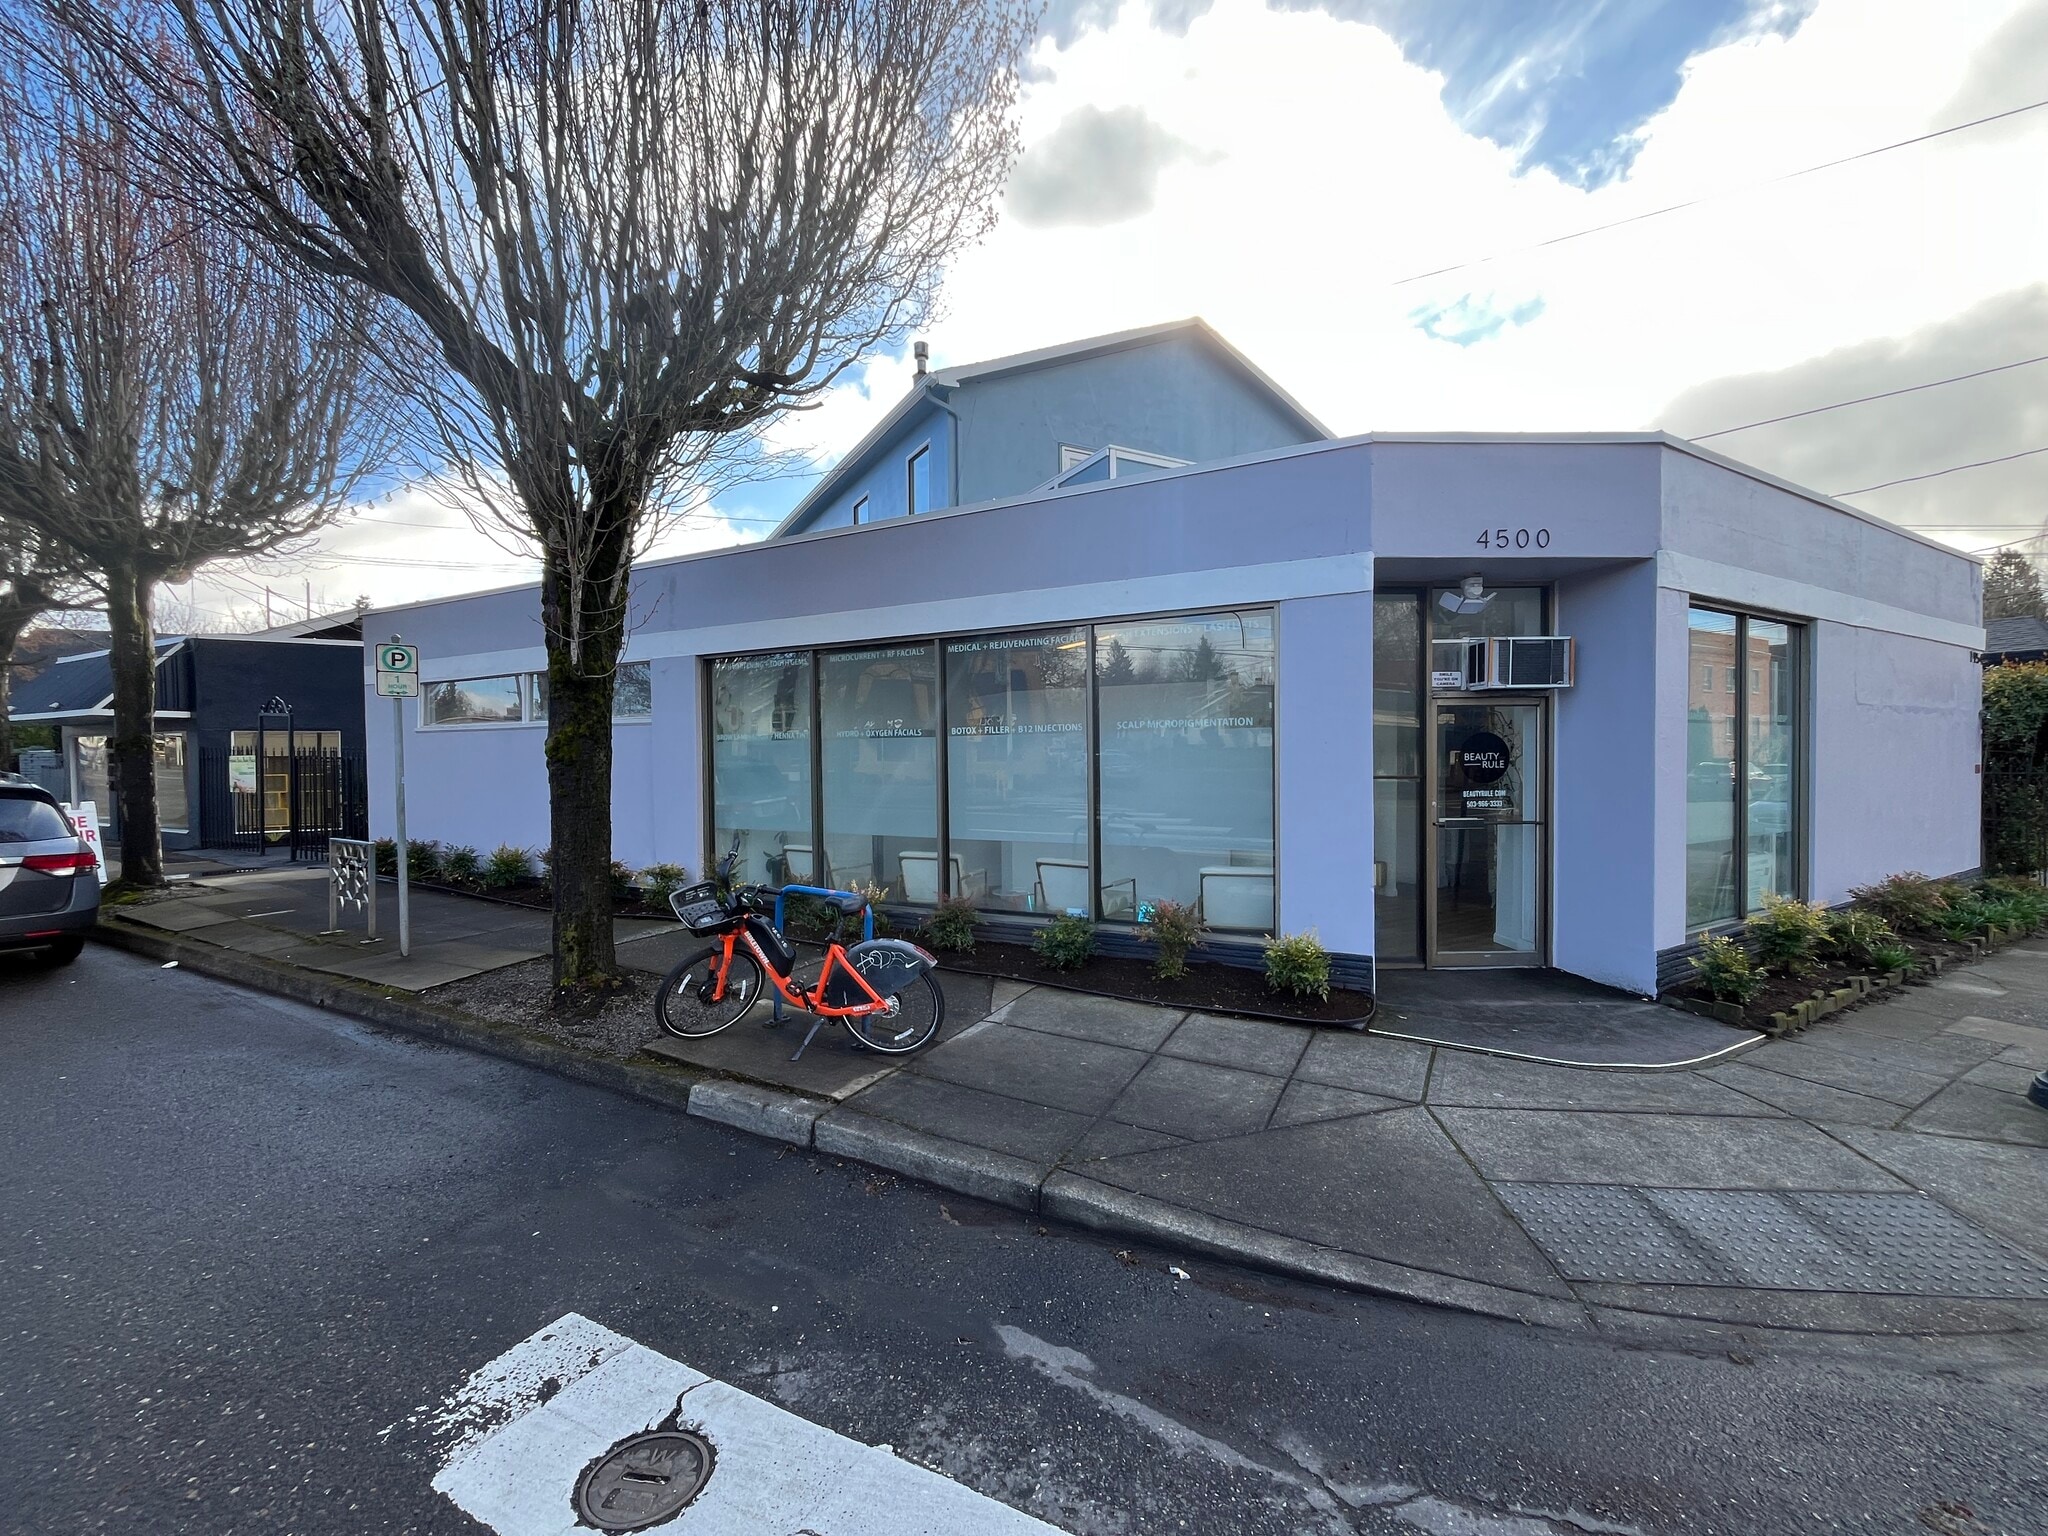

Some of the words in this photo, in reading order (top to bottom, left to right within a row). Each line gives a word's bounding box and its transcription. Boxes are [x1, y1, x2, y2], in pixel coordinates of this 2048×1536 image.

[1476, 528, 1550, 549] 4500
[947, 643, 981, 653] MEDICAL
[989, 637, 1049, 650] REJUVENATING
[391, 652, 405, 666] P
[829, 652, 880, 663] MICROCURRENT
[887, 650, 896, 658] RF
[896, 647, 925, 657] FACIALS
[394, 675, 400, 683] 1
[951, 727, 976, 735] BOTOX
[984, 726, 1010, 734] FILLER
[1018, 725, 1033, 733] B12
[1034, 723, 1083, 732] INJECTIONS
[1116, 721, 1146, 730] SCALP
[1147, 717, 1253, 729] MICROPIGMENTATION
[836, 730, 859, 738] HYDRO
[866, 729, 893, 737] OXYGEN
[894, 728, 922, 737] FACIALS
[1464, 752, 1500, 761] BEAUTY
[1482, 760, 1505, 768] RULE
